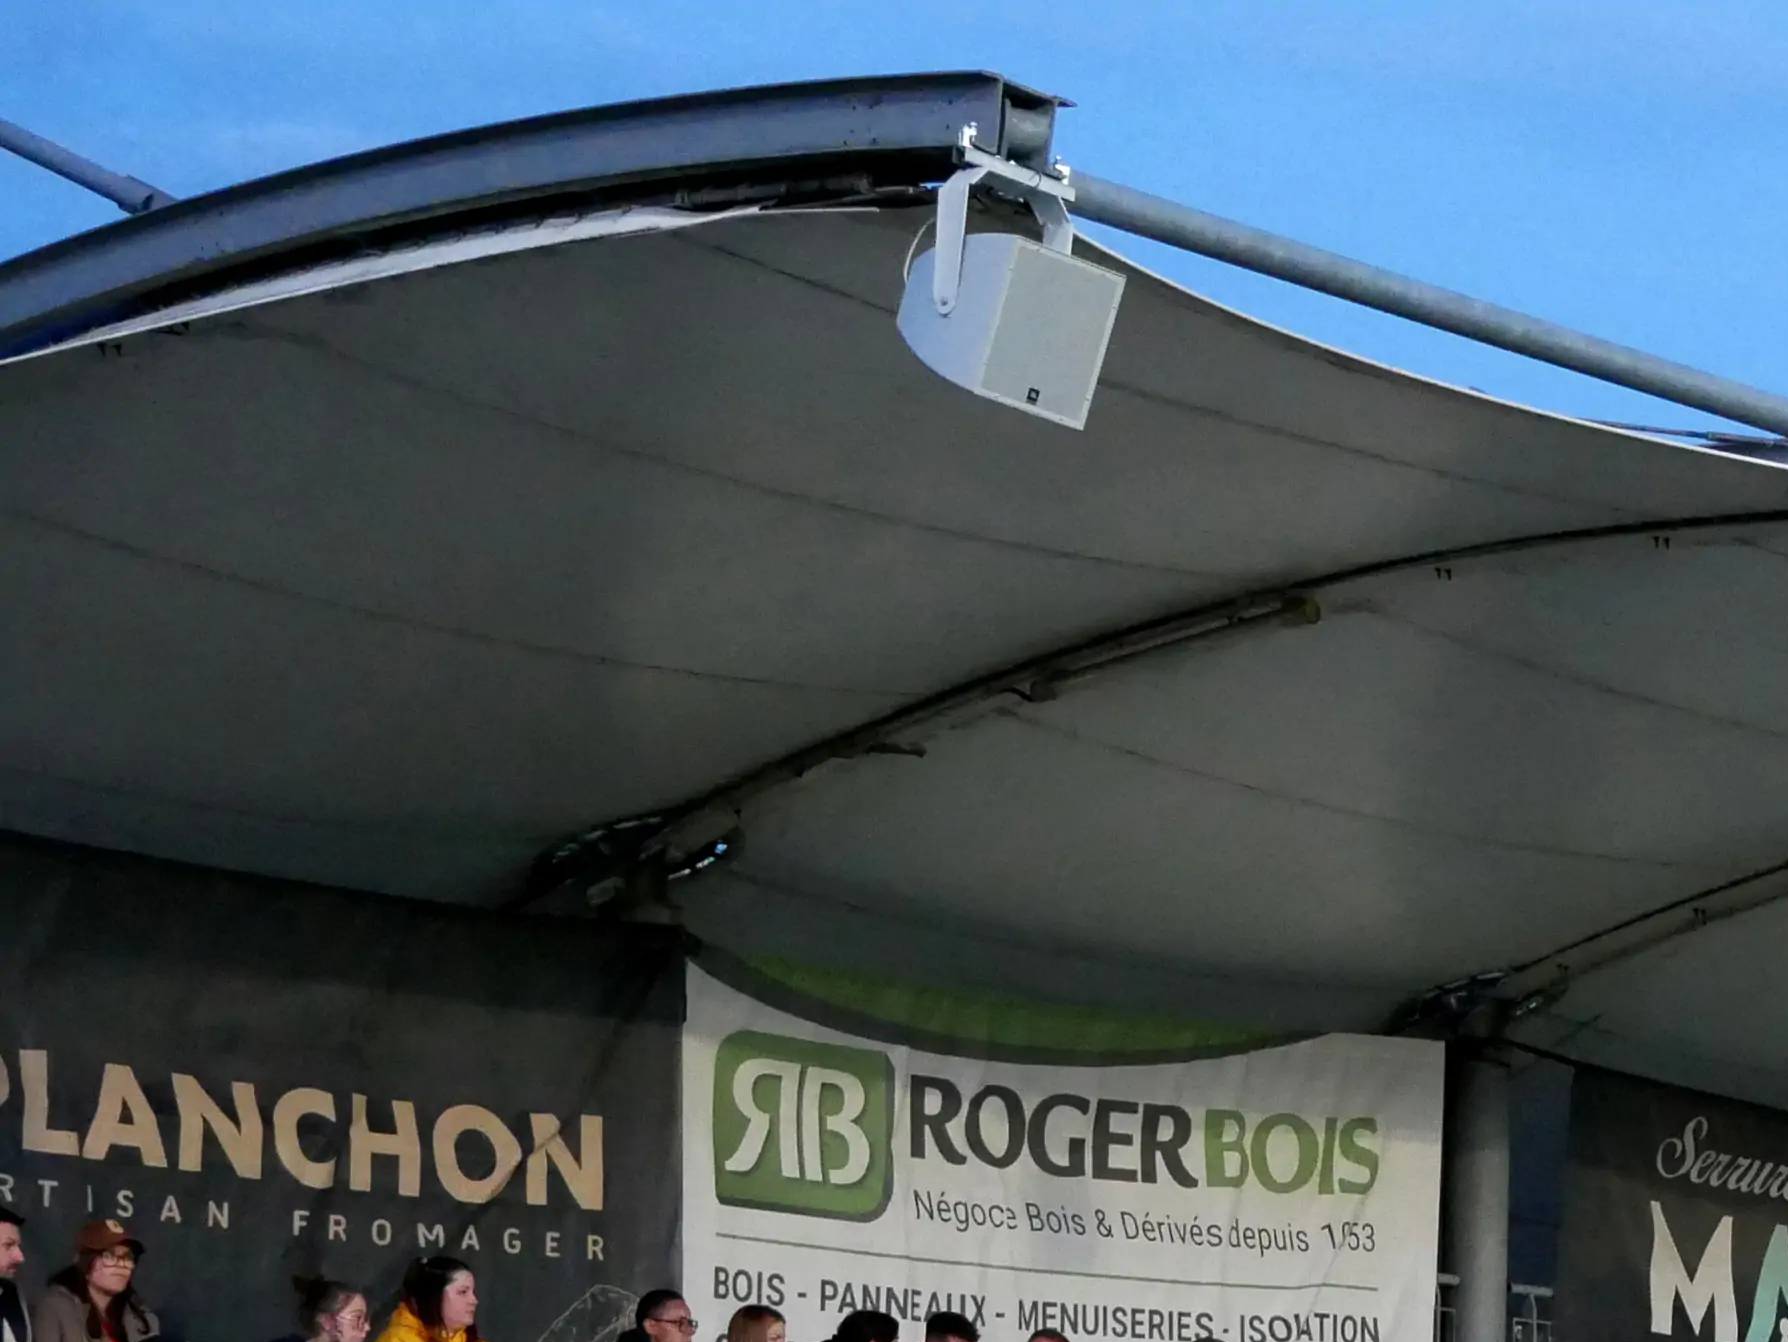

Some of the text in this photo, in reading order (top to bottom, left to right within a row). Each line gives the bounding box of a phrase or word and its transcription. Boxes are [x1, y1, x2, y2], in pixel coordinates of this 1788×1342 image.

[292, 1210, 604, 1261] FROMAGER
[913, 1189, 1018, 1232] Négoce
[1025, 1202, 1086, 1236] Bois
[1095, 1208, 1114, 1238] &
[1121, 1210, 1223, 1247] Dérivés
[1229, 1218, 1309, 1257] depuis
[713, 1266, 785, 1307] BOIS
[819, 1279, 986, 1327] PANNEAUX
[1018, 1299, 1214, 1342] MENUISERIES
